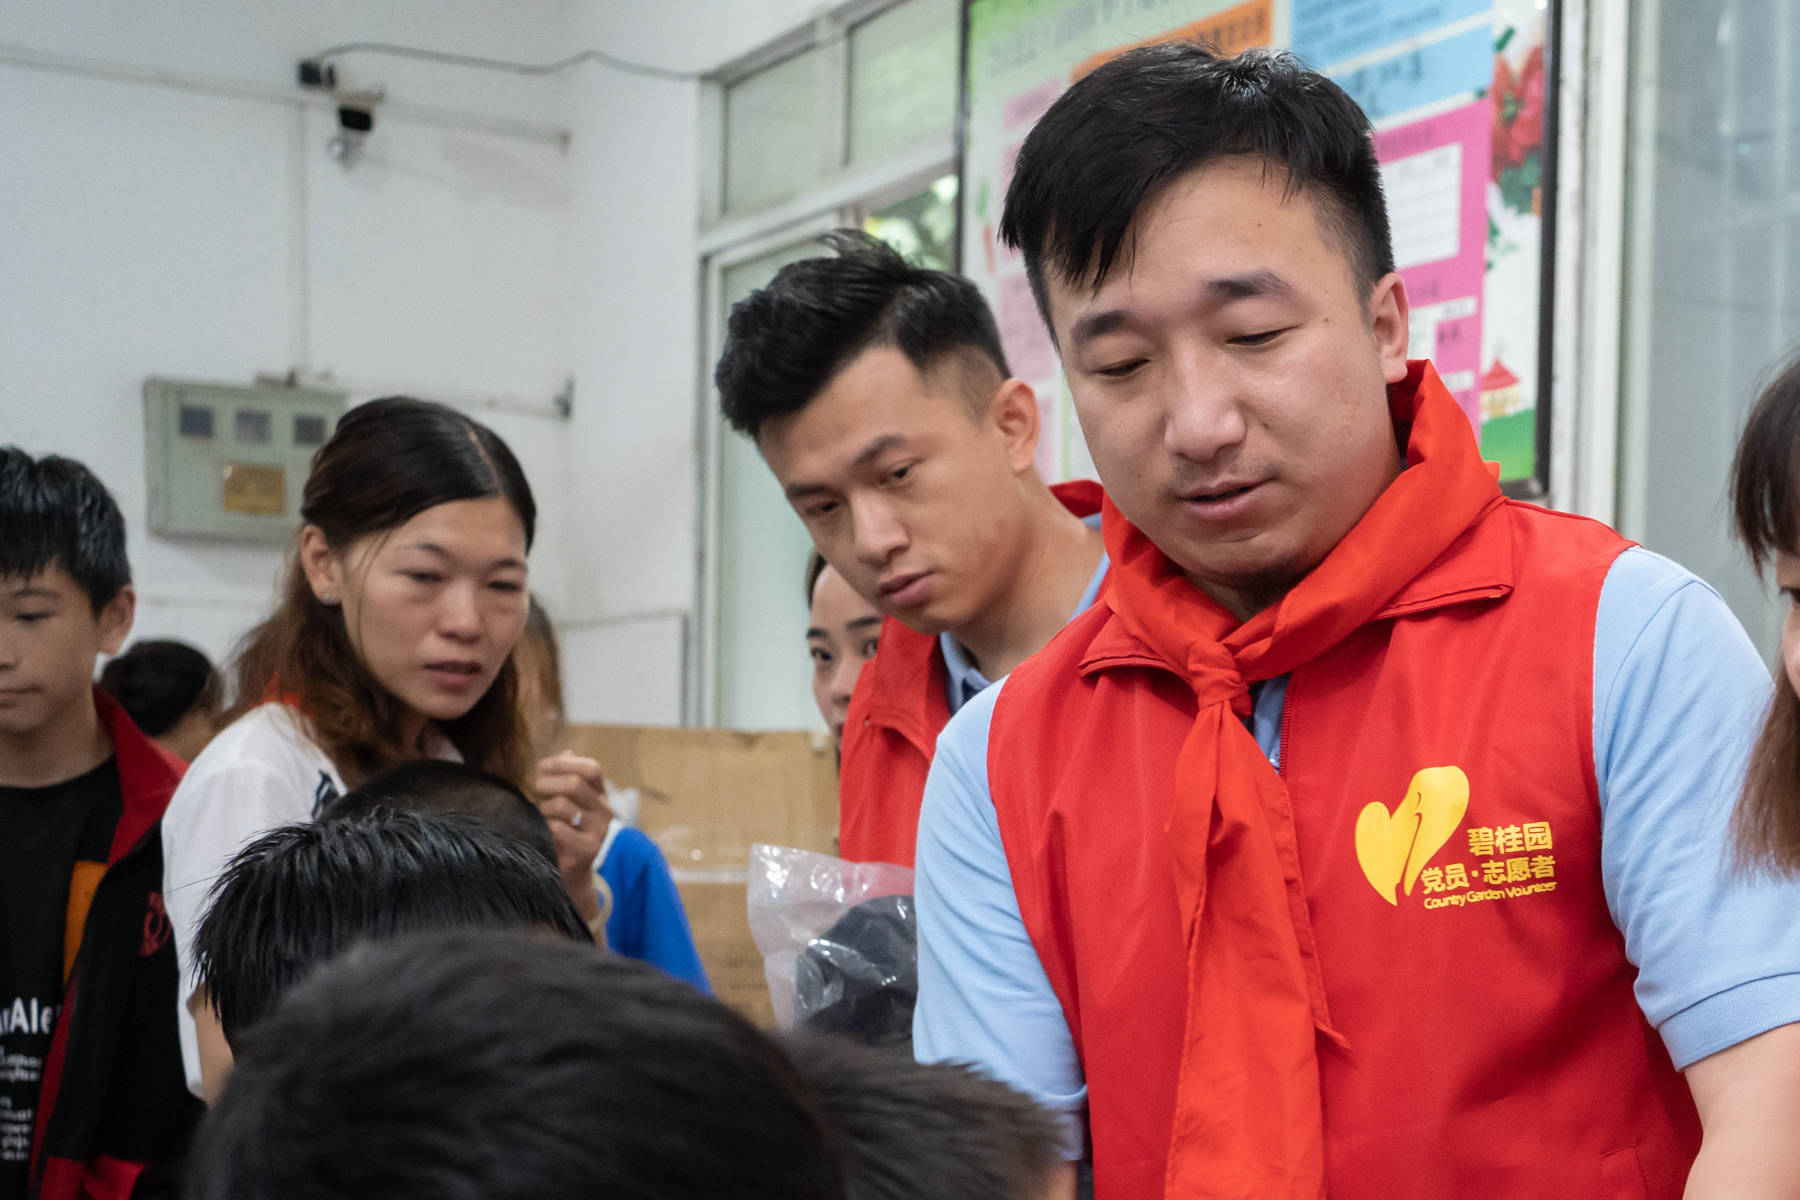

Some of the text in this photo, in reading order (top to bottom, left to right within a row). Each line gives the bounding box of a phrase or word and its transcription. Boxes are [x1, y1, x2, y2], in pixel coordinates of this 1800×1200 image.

[1466, 821, 1553, 856] 碧桂园
[1420, 855, 1556, 895] 党员·志愿者
[1423, 881, 1557, 909] Country Garden Volunteer
